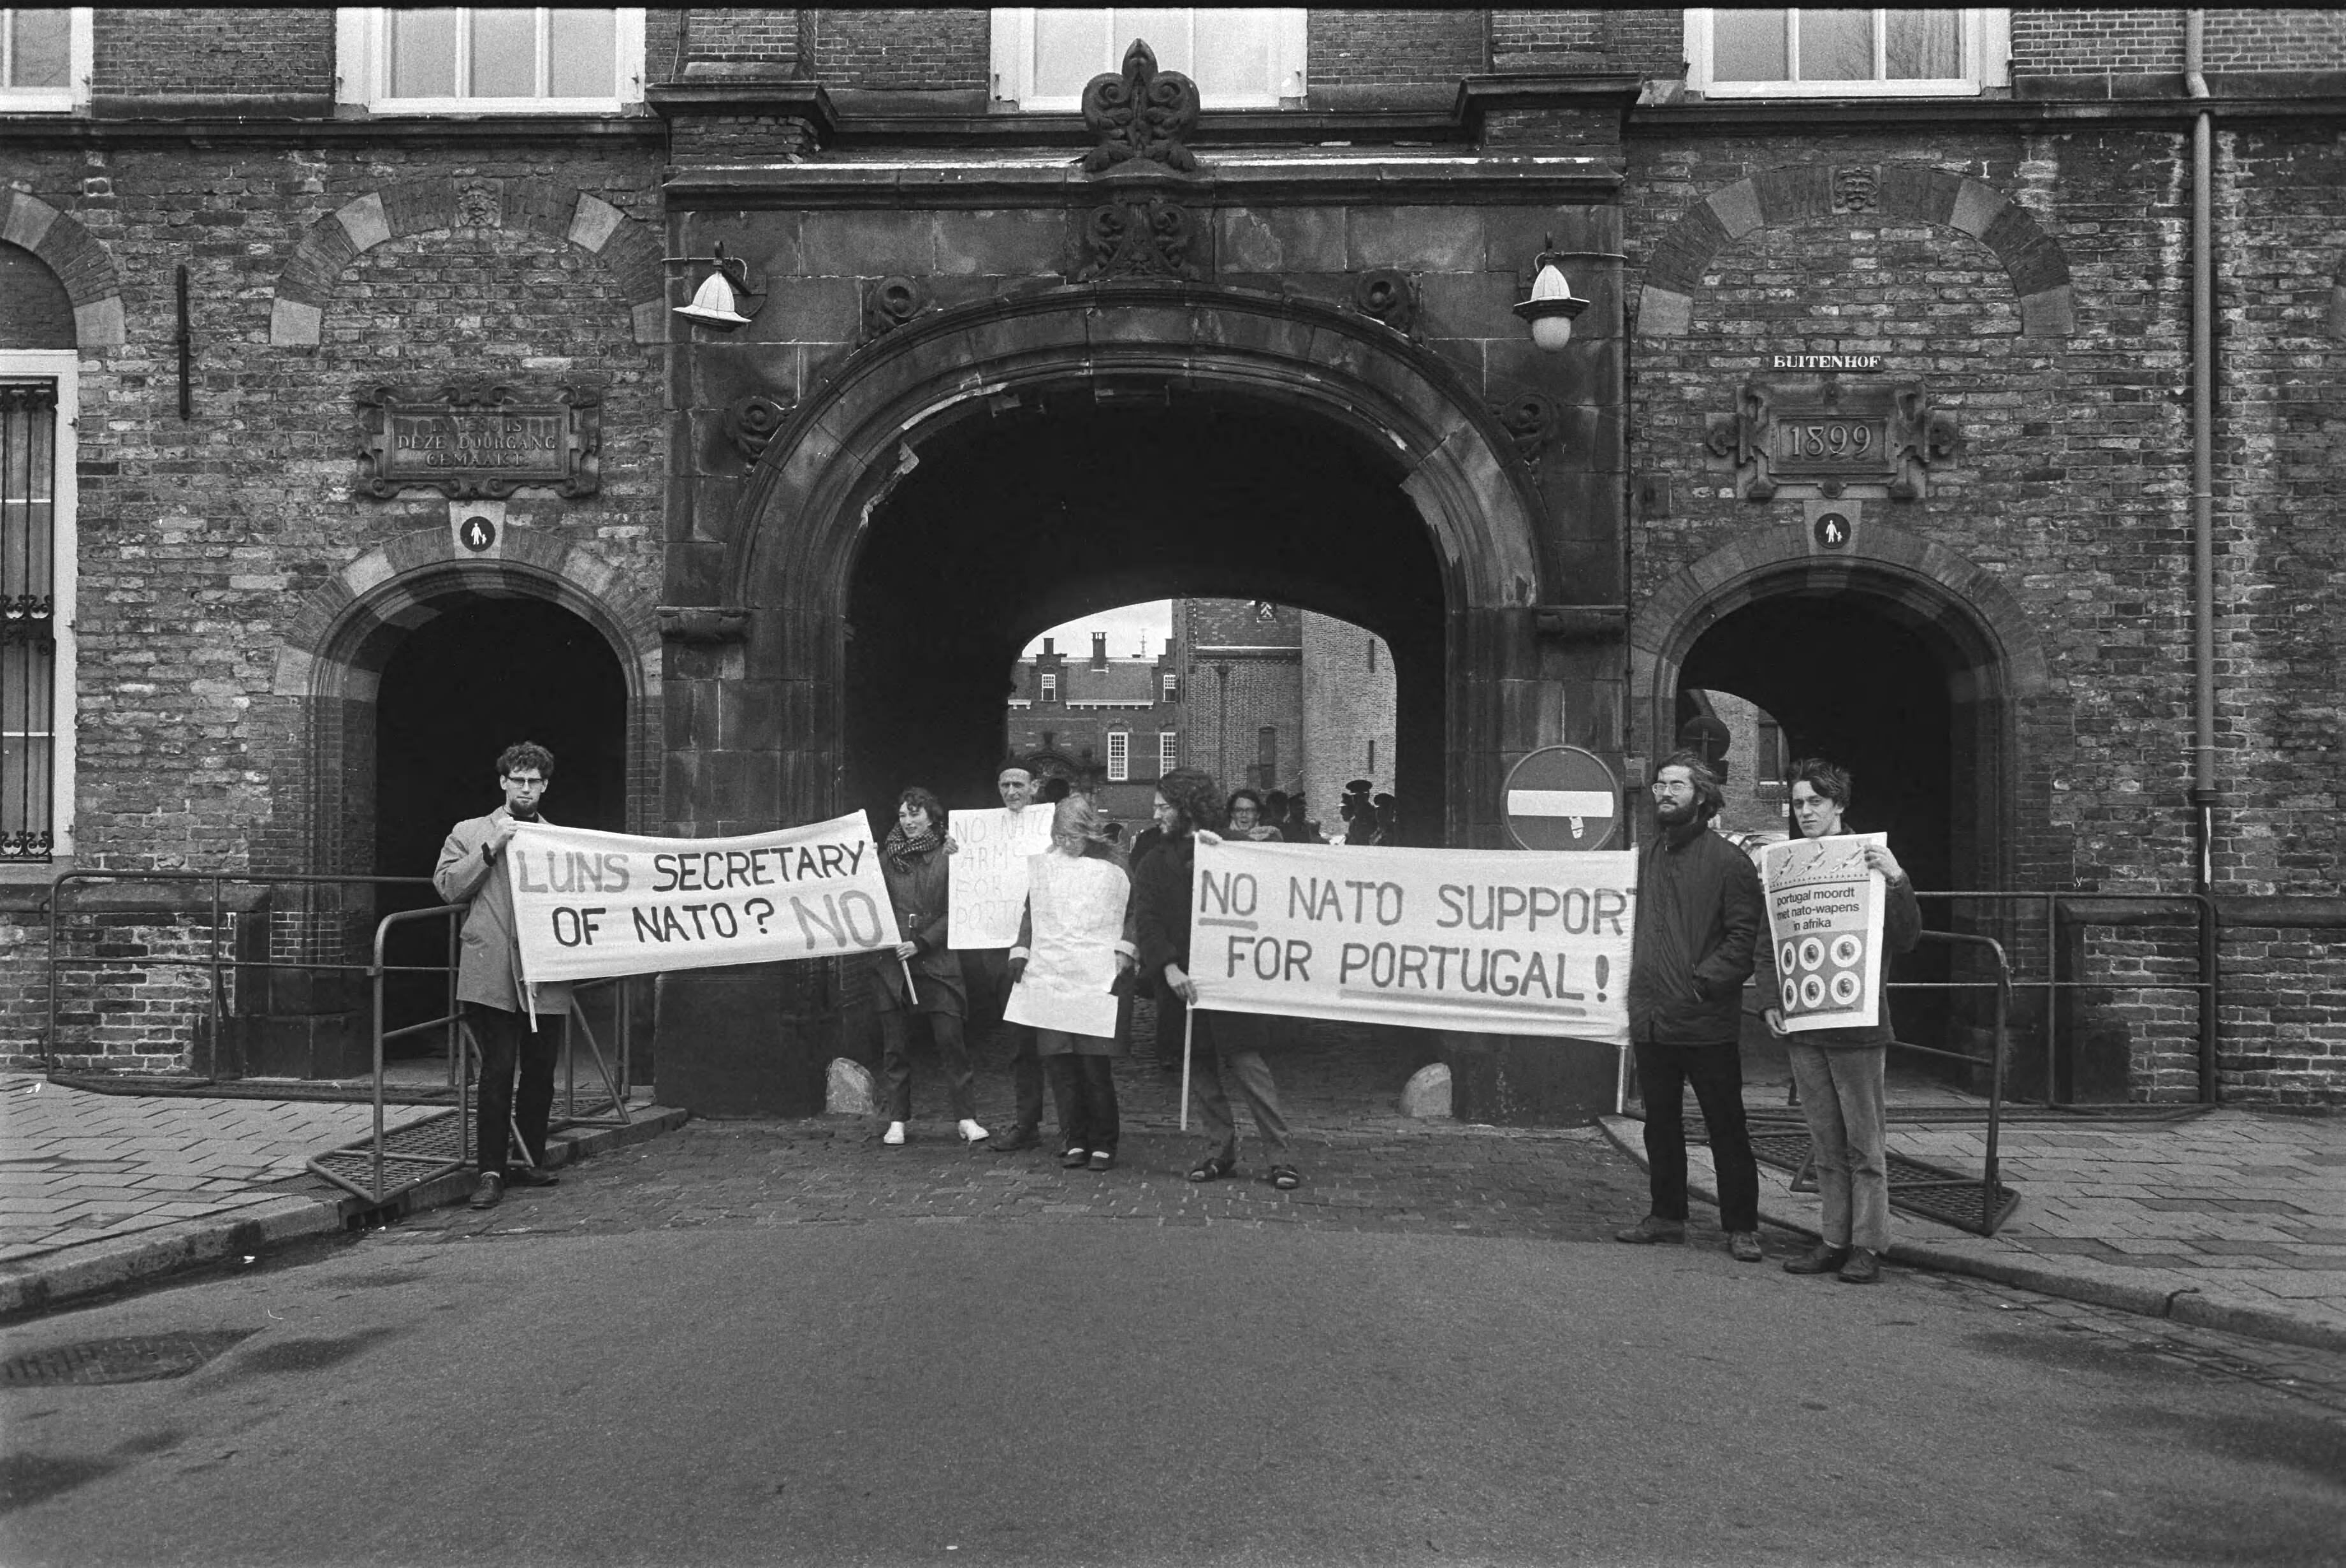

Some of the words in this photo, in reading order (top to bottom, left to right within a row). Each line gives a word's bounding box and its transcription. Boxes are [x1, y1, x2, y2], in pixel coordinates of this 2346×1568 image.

[1774, 355, 1881, 368] BUITENHOF
[507, 418, 523, 432] IS
[398, 435, 446, 449] DEZE
[459, 435, 556, 449] DOORGANG
[1791, 425, 1870, 456] 1899
[954, 816, 986, 844] NO
[516, 849, 630, 894] LUNS
[652, 840, 865, 892] SECRETARY
[960, 842, 1010, 871] ARM
[955, 875, 1003, 900] FOR
[1777, 890, 1811, 908] portugal
[1813, 887, 1855, 899] moordt
[1197, 870, 1257, 917] NO
[1288, 876, 1404, 926] NATO
[1436, 884, 1636, 936] SUPPOR
[1777, 908, 1790, 920] met
[1791, 903, 1860, 917] nato-wapens
[551, 906, 607, 948] OF
[789, 889, 884, 950] NO
[1793, 920, 1801, 931] in
[1802, 918, 1832, 930] afrika
[1227, 935, 1313, 982] FOR
